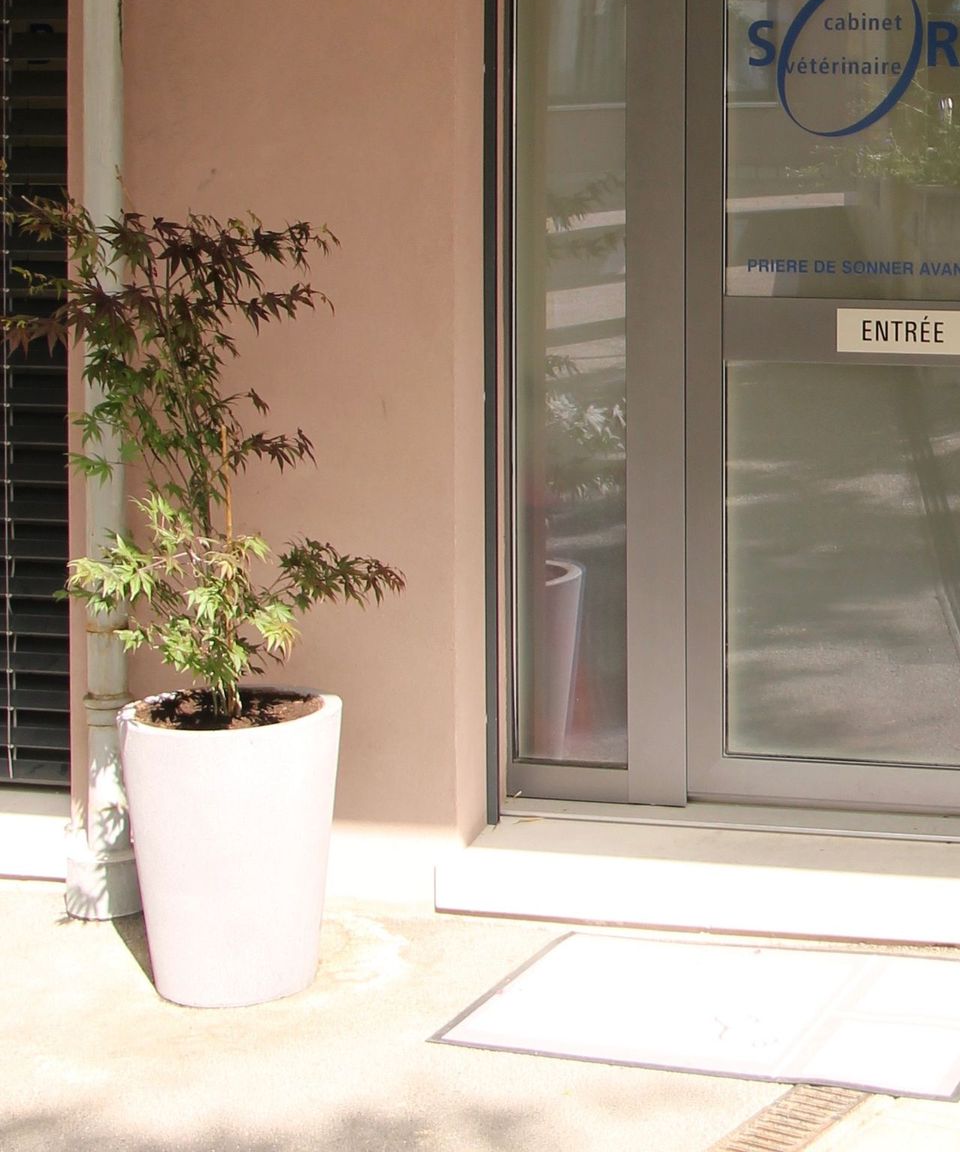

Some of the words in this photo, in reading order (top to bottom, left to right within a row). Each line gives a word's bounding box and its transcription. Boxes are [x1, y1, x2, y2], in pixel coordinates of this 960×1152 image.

[824, 12, 902, 31] cabinet
[784, 57, 901, 75] vétérinaire
[747, 259, 808, 273] PRIERE
[814, 260, 836, 274] DE
[842, 260, 914, 276] SONNER
[861, 315, 945, 344] ENTRÉE
